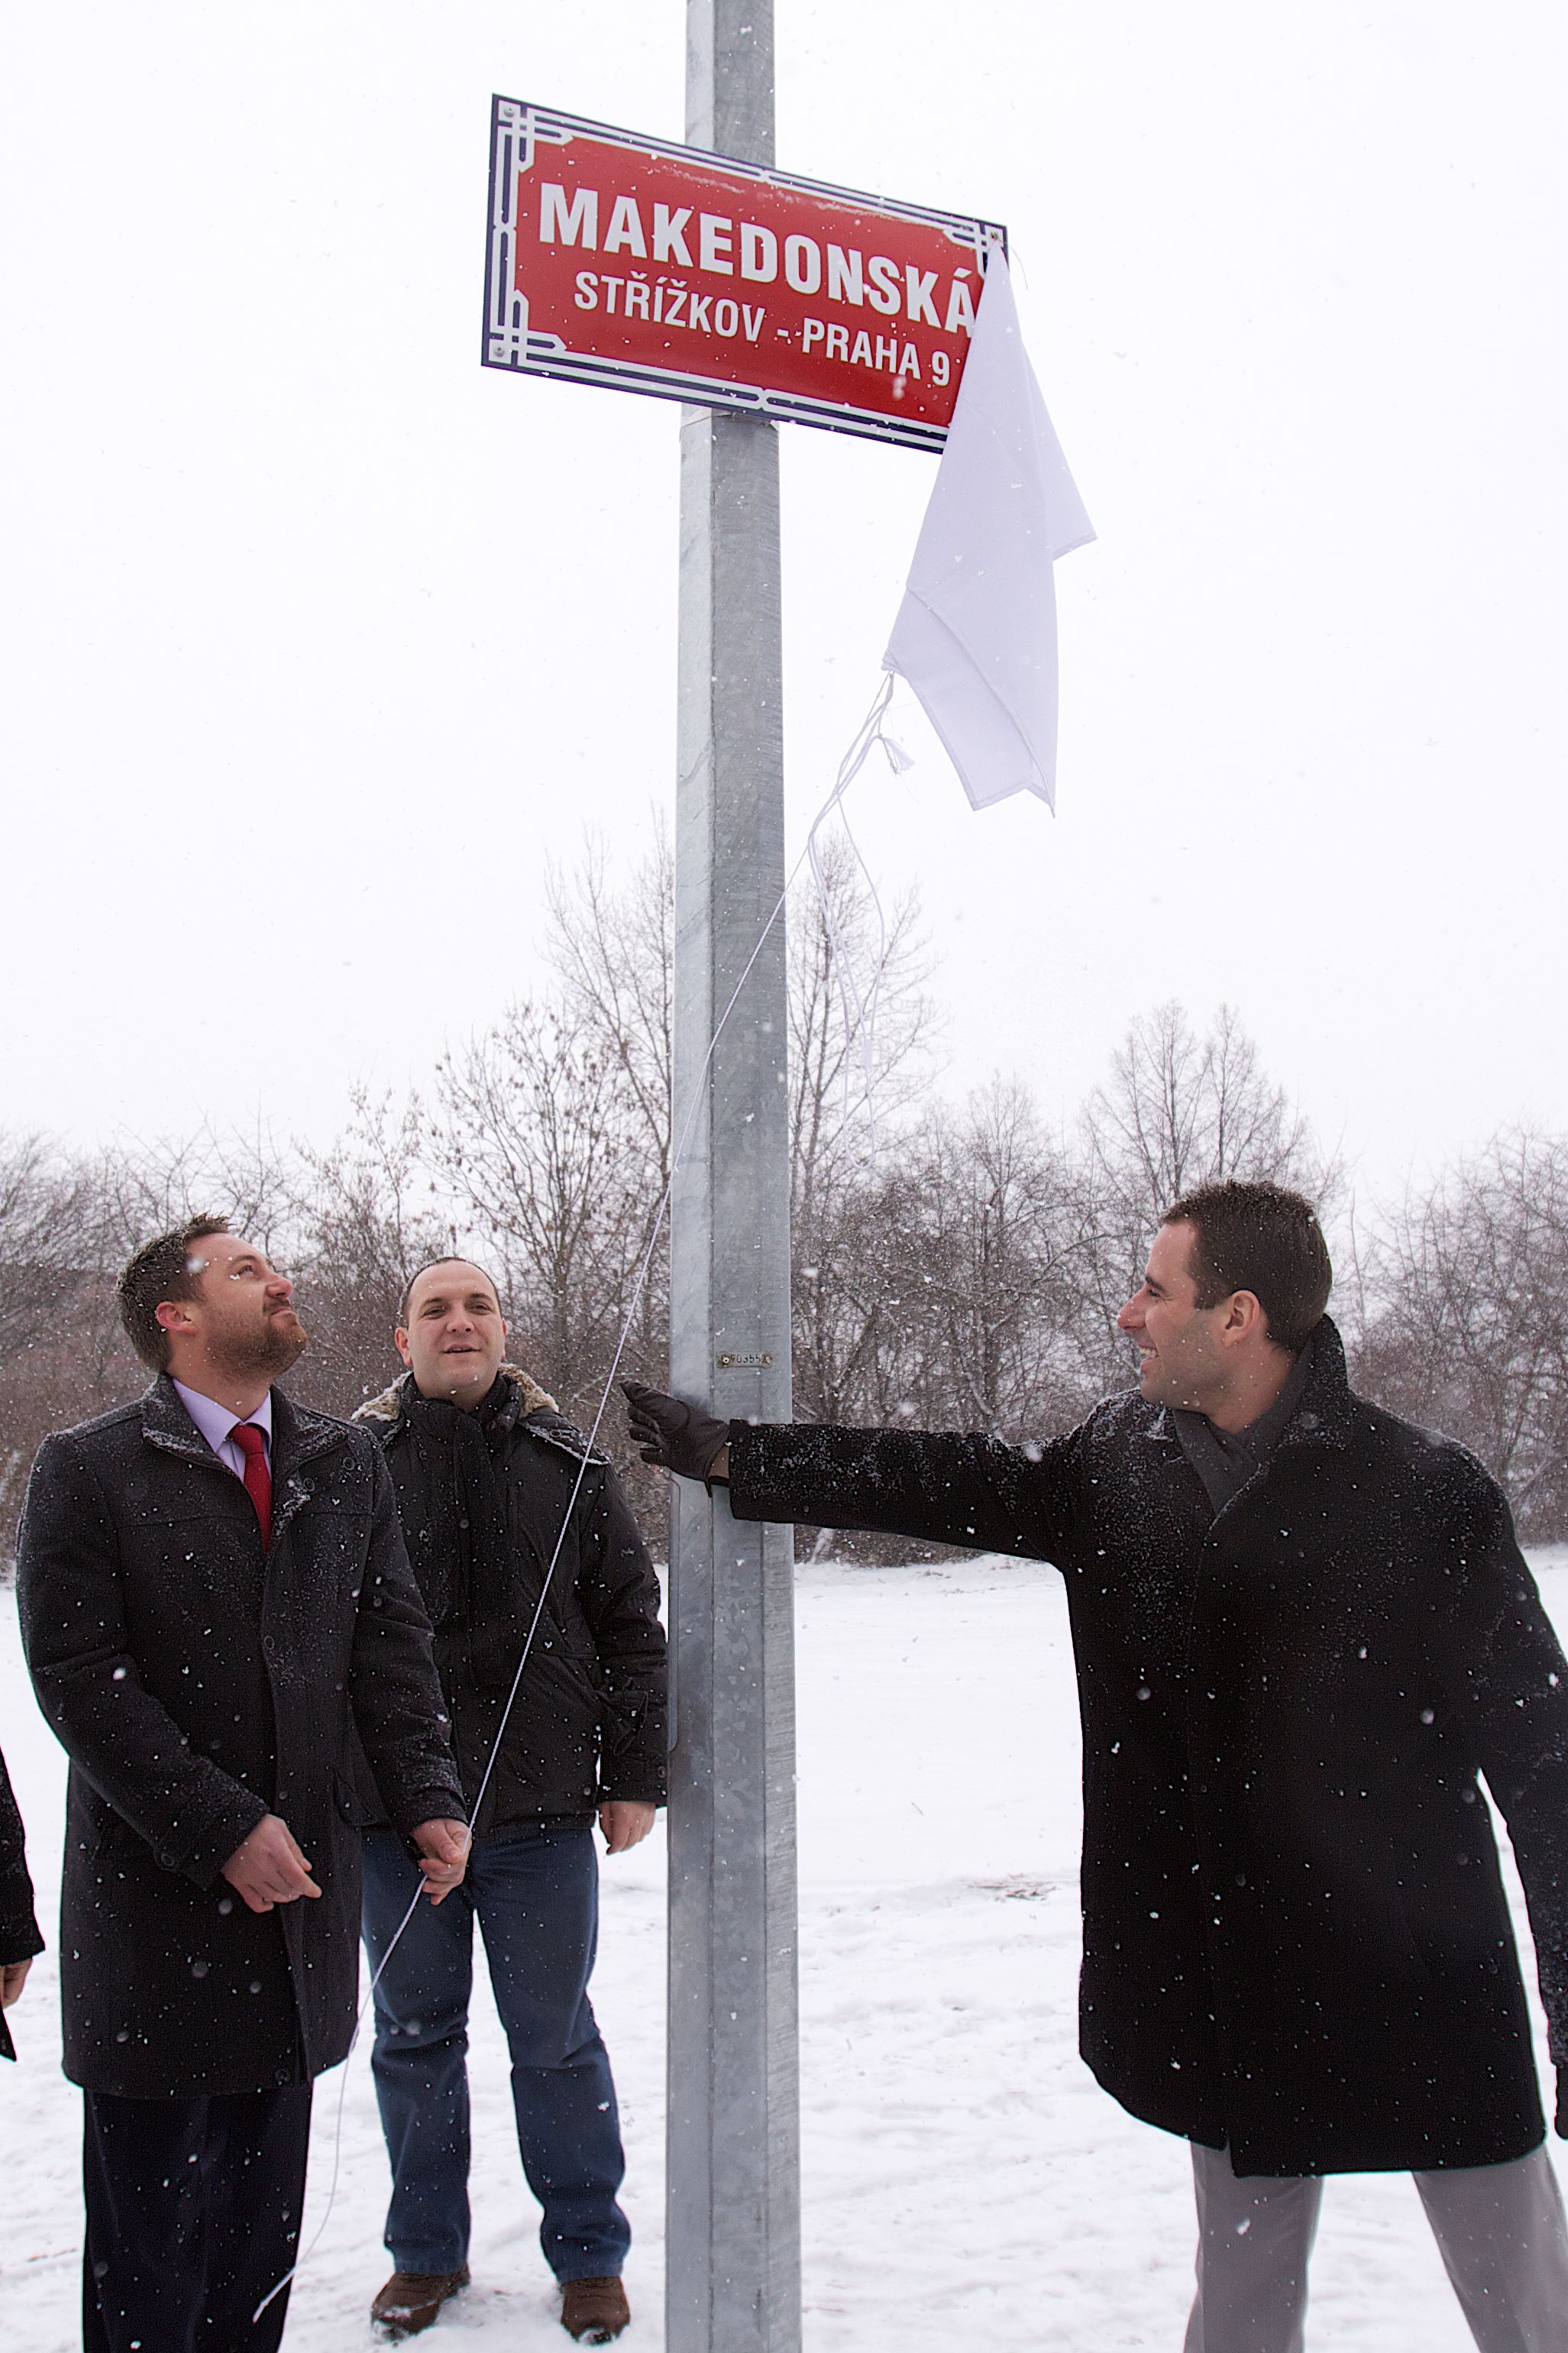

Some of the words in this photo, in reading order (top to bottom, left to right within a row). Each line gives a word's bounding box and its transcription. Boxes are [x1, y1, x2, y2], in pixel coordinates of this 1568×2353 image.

[539, 181, 975, 338] MAKEDONSKÁ
[574, 270, 765, 342] STŘÍŽKOV
[802, 317, 921, 379] PRAHA
[932, 350, 950, 387] 9
